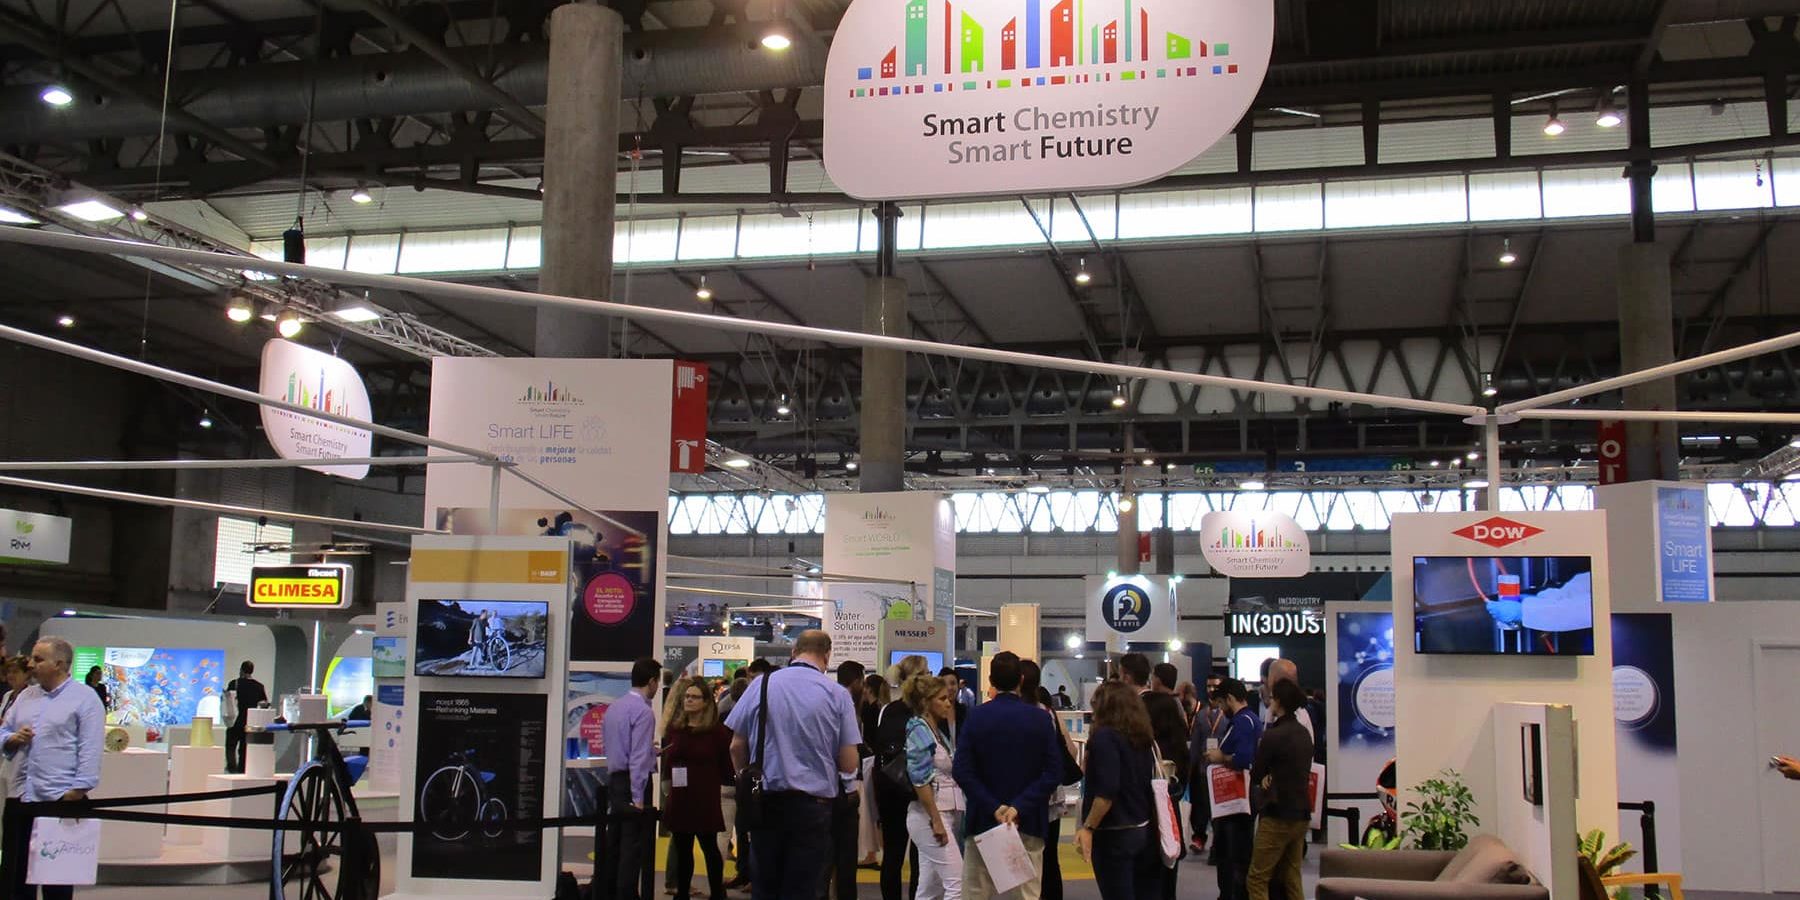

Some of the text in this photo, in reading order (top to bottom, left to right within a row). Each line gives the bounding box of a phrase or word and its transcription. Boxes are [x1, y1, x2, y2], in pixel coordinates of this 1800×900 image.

[923, 103, 1160, 136] Smart Chemistry
[948, 134, 1133, 164] Smart Future
[487, 423, 575, 440] Smart LIFE
[290, 427, 348, 453] Smart Chemistry
[295, 442, 317, 457] Smart
[545, 446, 577, 455] mejorar
[540, 456, 577, 464] personas
[1665, 541, 1703, 558] Smart
[1671, 559, 1697, 573] LIFE
[257, 583, 336, 598] CLIMESA
[834, 611, 861, 620] Water
[834, 621, 876, 631] Solutions
